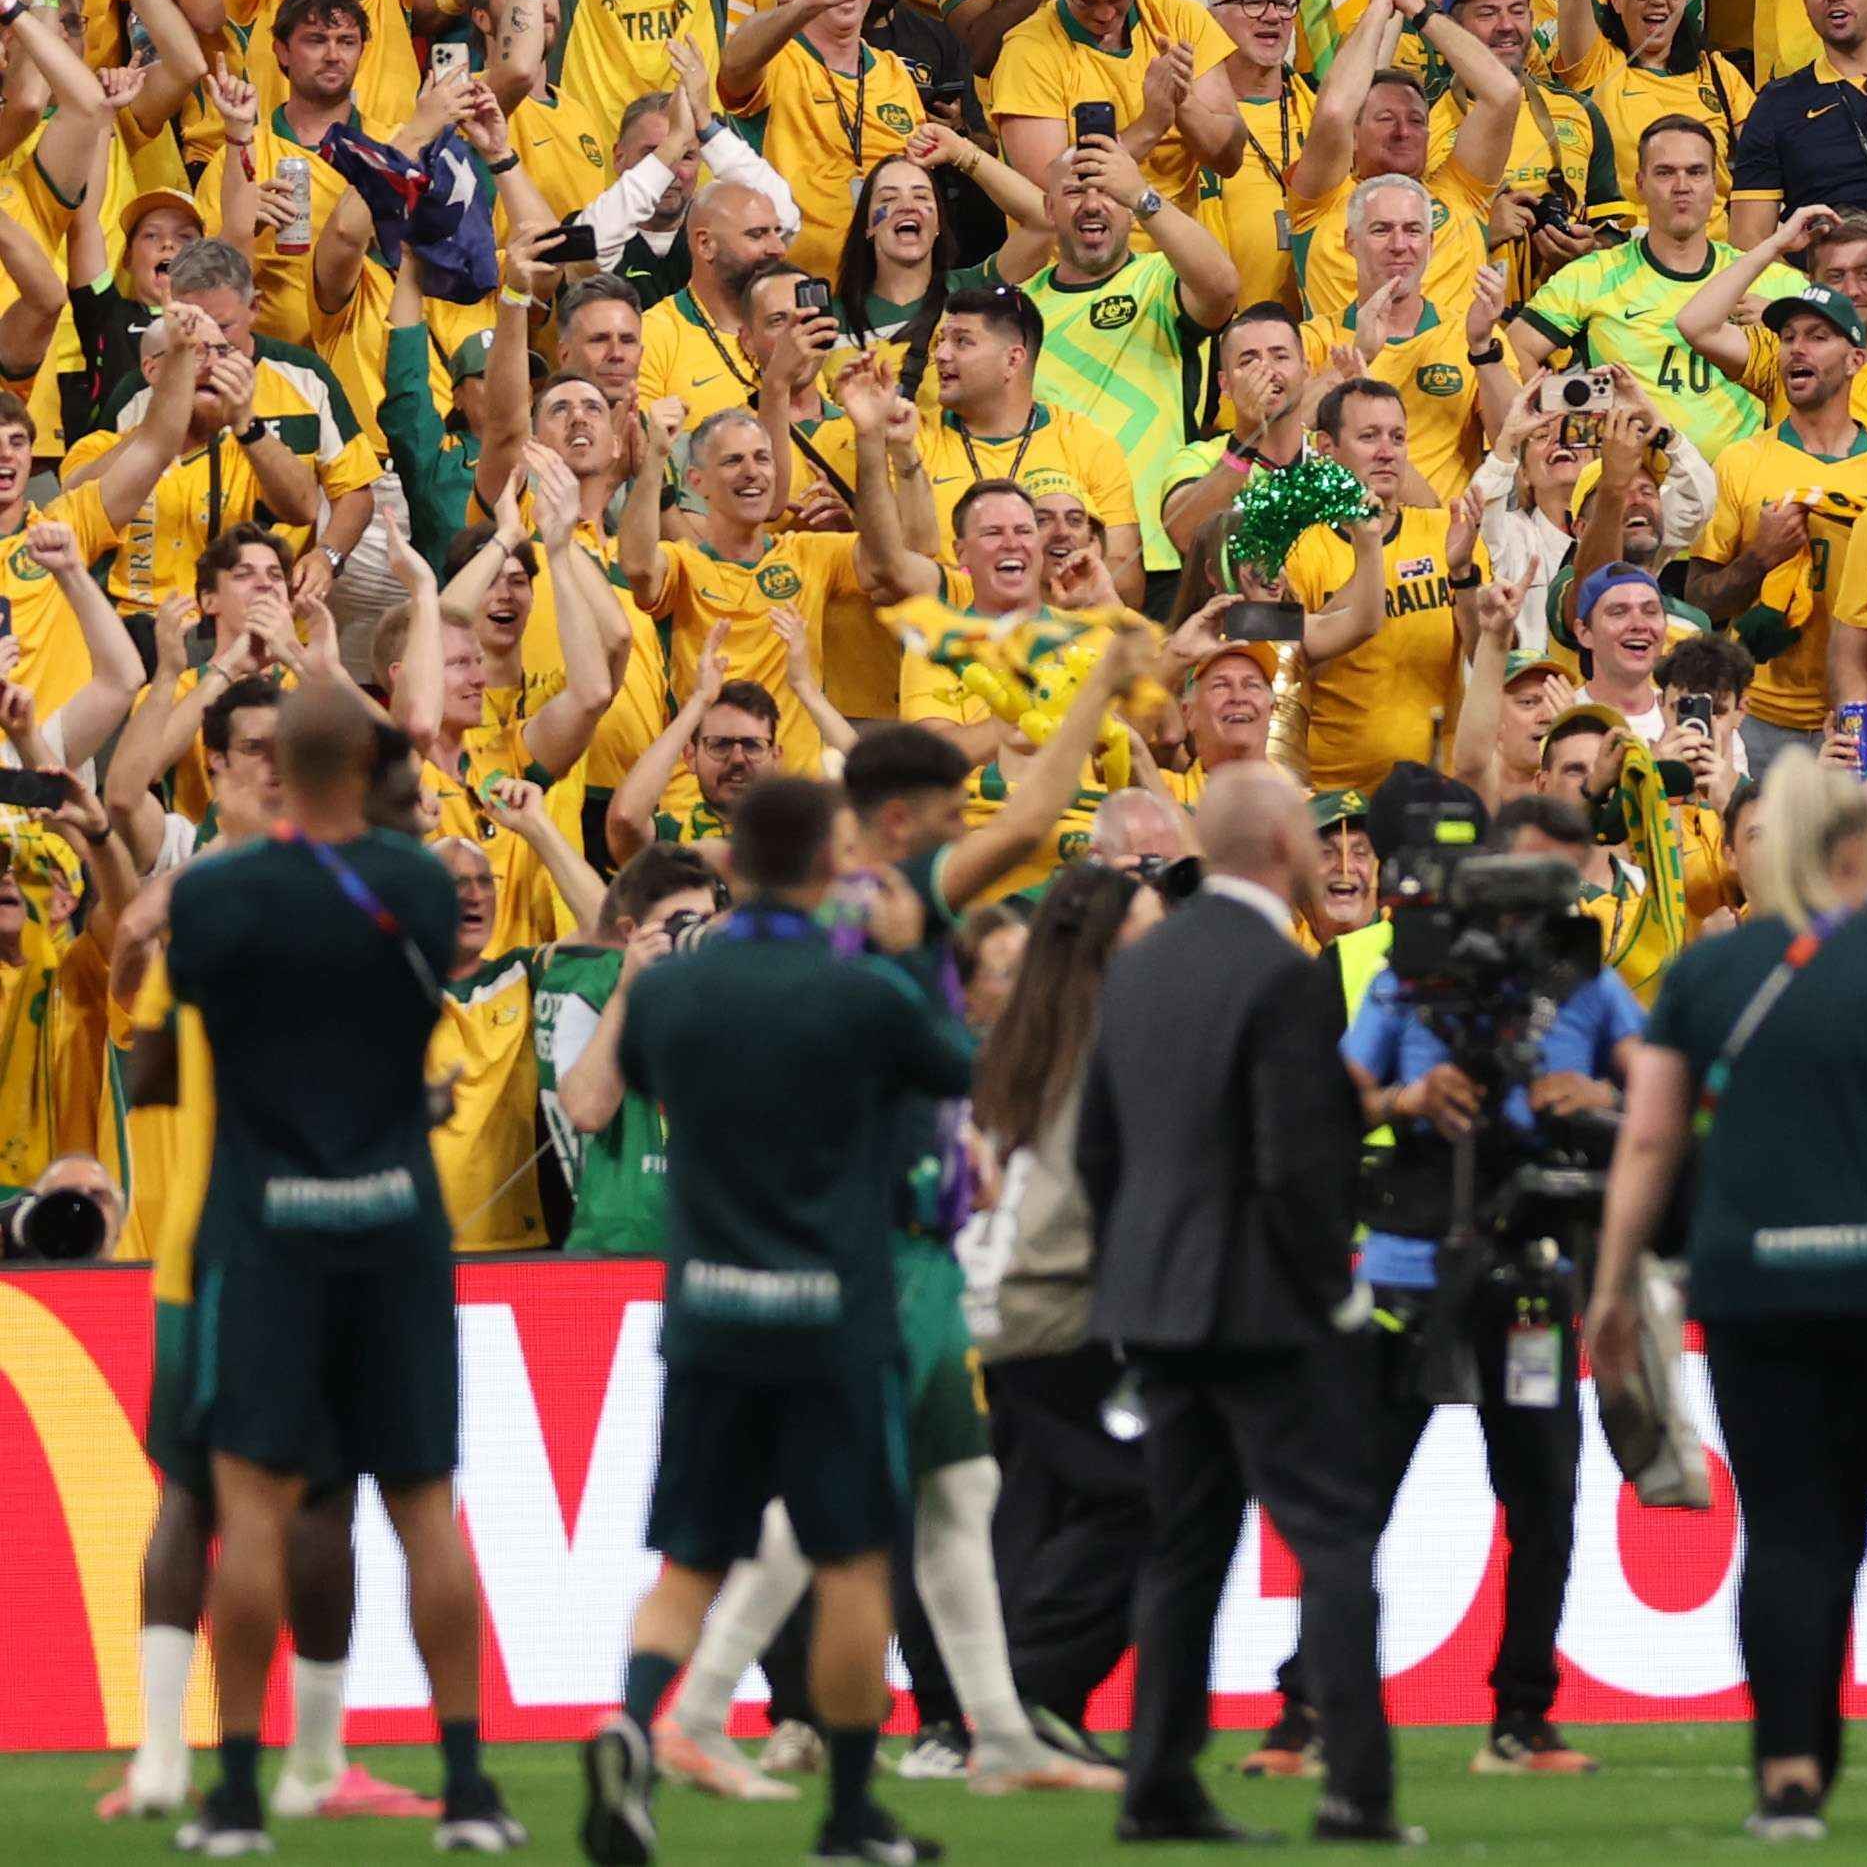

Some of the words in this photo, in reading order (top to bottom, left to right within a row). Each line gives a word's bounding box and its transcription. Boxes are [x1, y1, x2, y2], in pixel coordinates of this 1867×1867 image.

[1802, 286, 1832, 305] US
[1657, 345, 1711, 394] 40
[1384, 578, 1454, 618] RALIA
